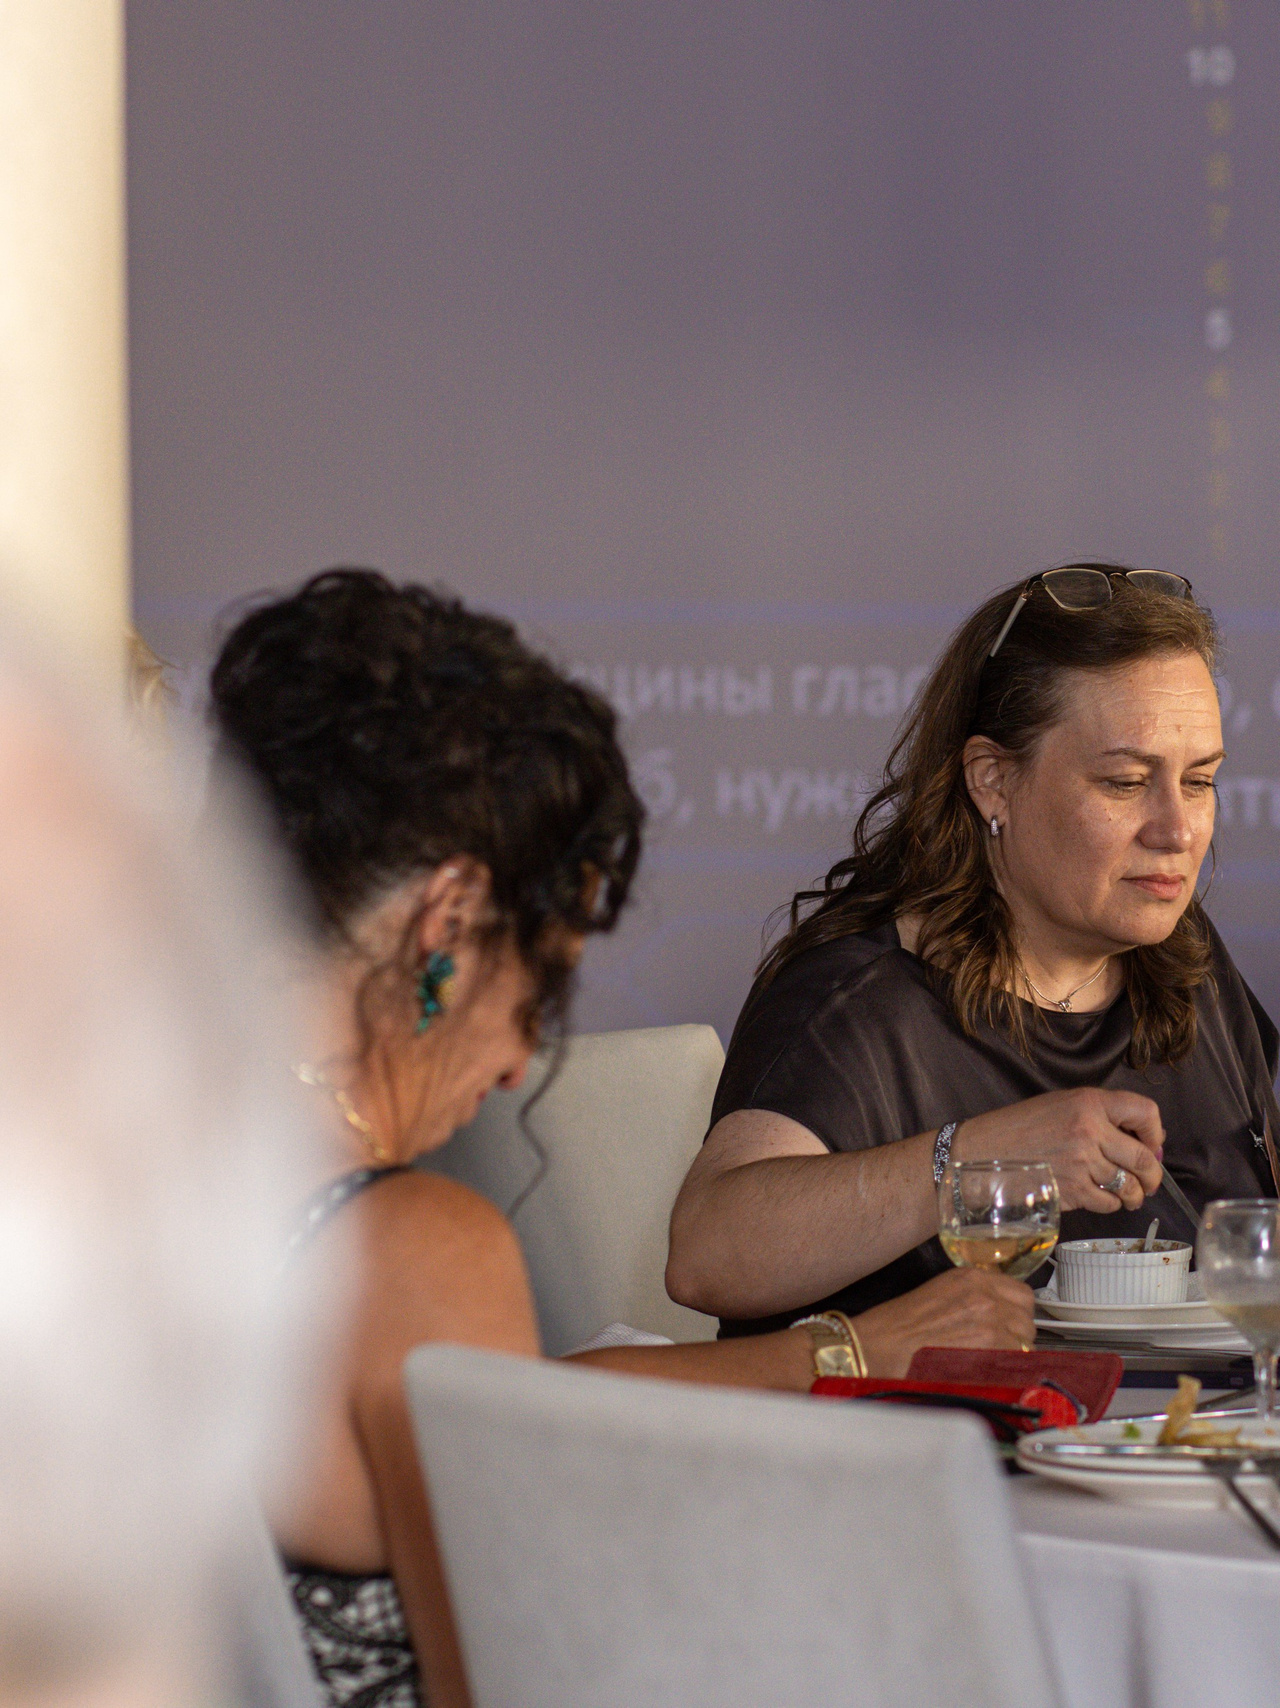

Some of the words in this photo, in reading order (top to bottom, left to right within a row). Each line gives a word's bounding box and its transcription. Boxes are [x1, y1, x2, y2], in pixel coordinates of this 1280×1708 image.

[1188, 45, 1235, 85] 10
[1205, 309, 1233, 349] 5
[570, 663, 772, 724] щины
[793, 664, 934, 718] глас
[715, 768, 868, 834] нуж
